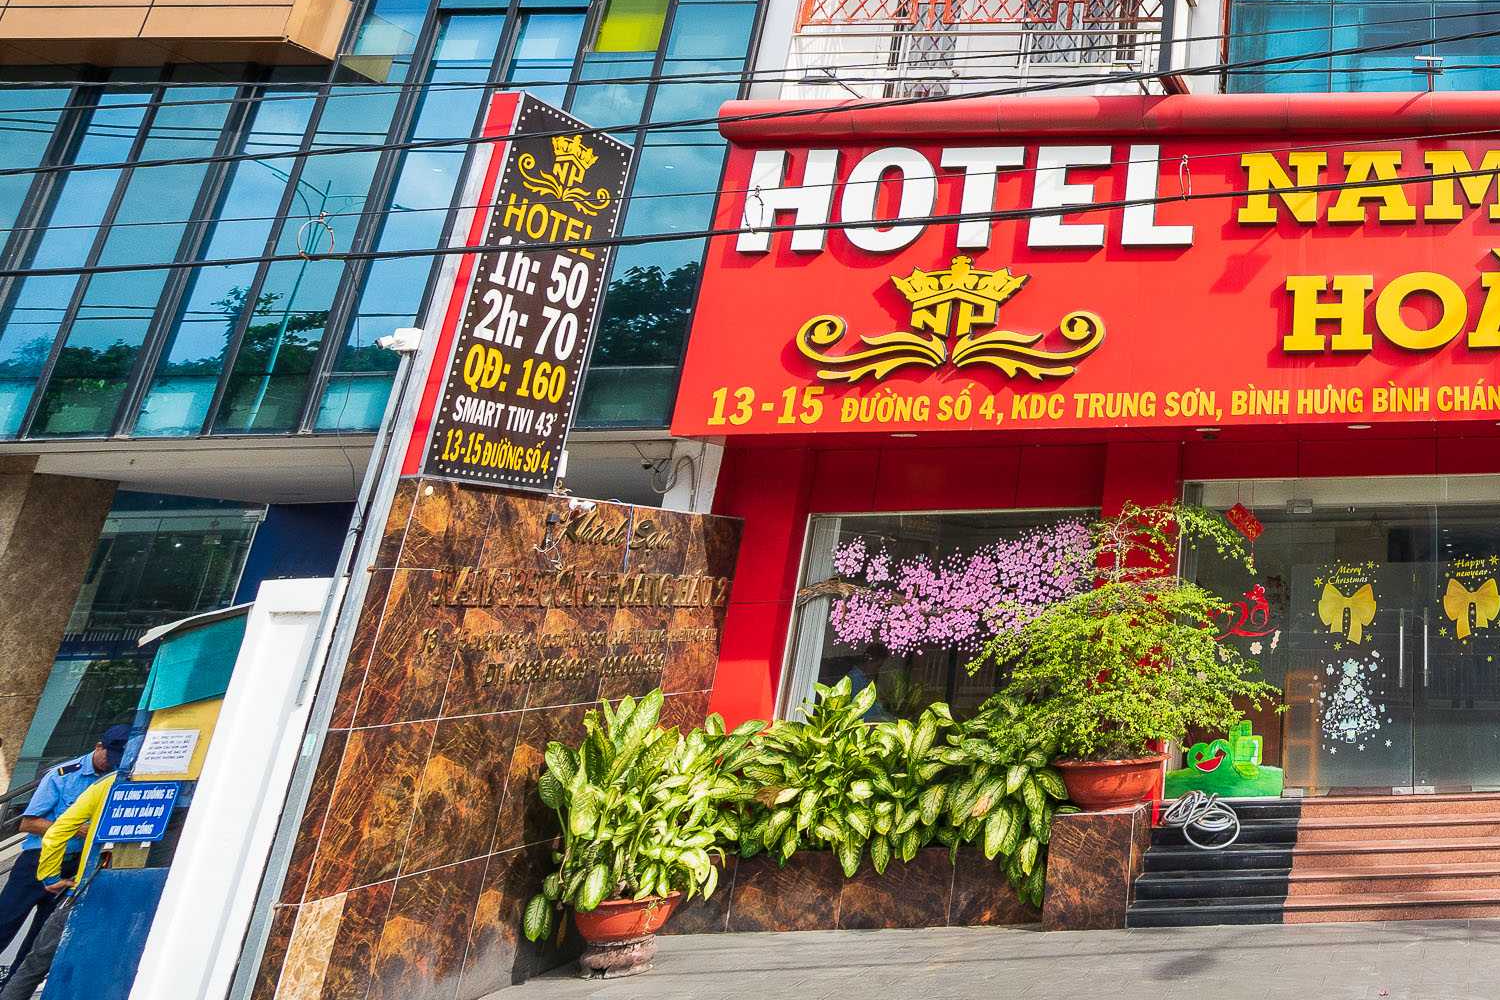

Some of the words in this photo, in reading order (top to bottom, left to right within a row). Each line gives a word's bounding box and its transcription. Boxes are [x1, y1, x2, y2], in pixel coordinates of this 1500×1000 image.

[735, 144, 1195, 255] HOTEL
[503, 192, 596, 260] HOTEL
[489, 235, 542, 295] 1h:
[546, 254, 589, 310] 50
[473, 288, 529, 350] 2h:
[534, 305, 579, 361] 70
[463, 343, 511, 393] QĐ:
[516, 358, 567, 404] 160
[452, 394, 505, 429] SMART
[506, 404, 535, 434] TIVI
[840, 387, 930, 423] ĐƯỜNG
[936, 382, 976, 422] SỐ
[978, 394, 1005, 426] 4,
[1011, 394, 1066, 420] KDC
[1073, 392, 1157, 419] TRUNG
[1163, 387, 1223, 421] SƠN,
[1231, 384, 1290, 417] BÌNH
[1296, 384, 1364, 415] HƯNG
[1371, 381, 1430, 414] BÌNH
[442, 428, 485, 465] 13-15
[481, 437, 525, 471] ĐƯỜNG
[523, 440, 546, 474] SỐ
[541, 450, 551, 474] 4
[1328, 575, 1368, 586] Christmas
[1336, 566, 1362, 577] Merry
[1454, 558, 1485, 569] Happy
